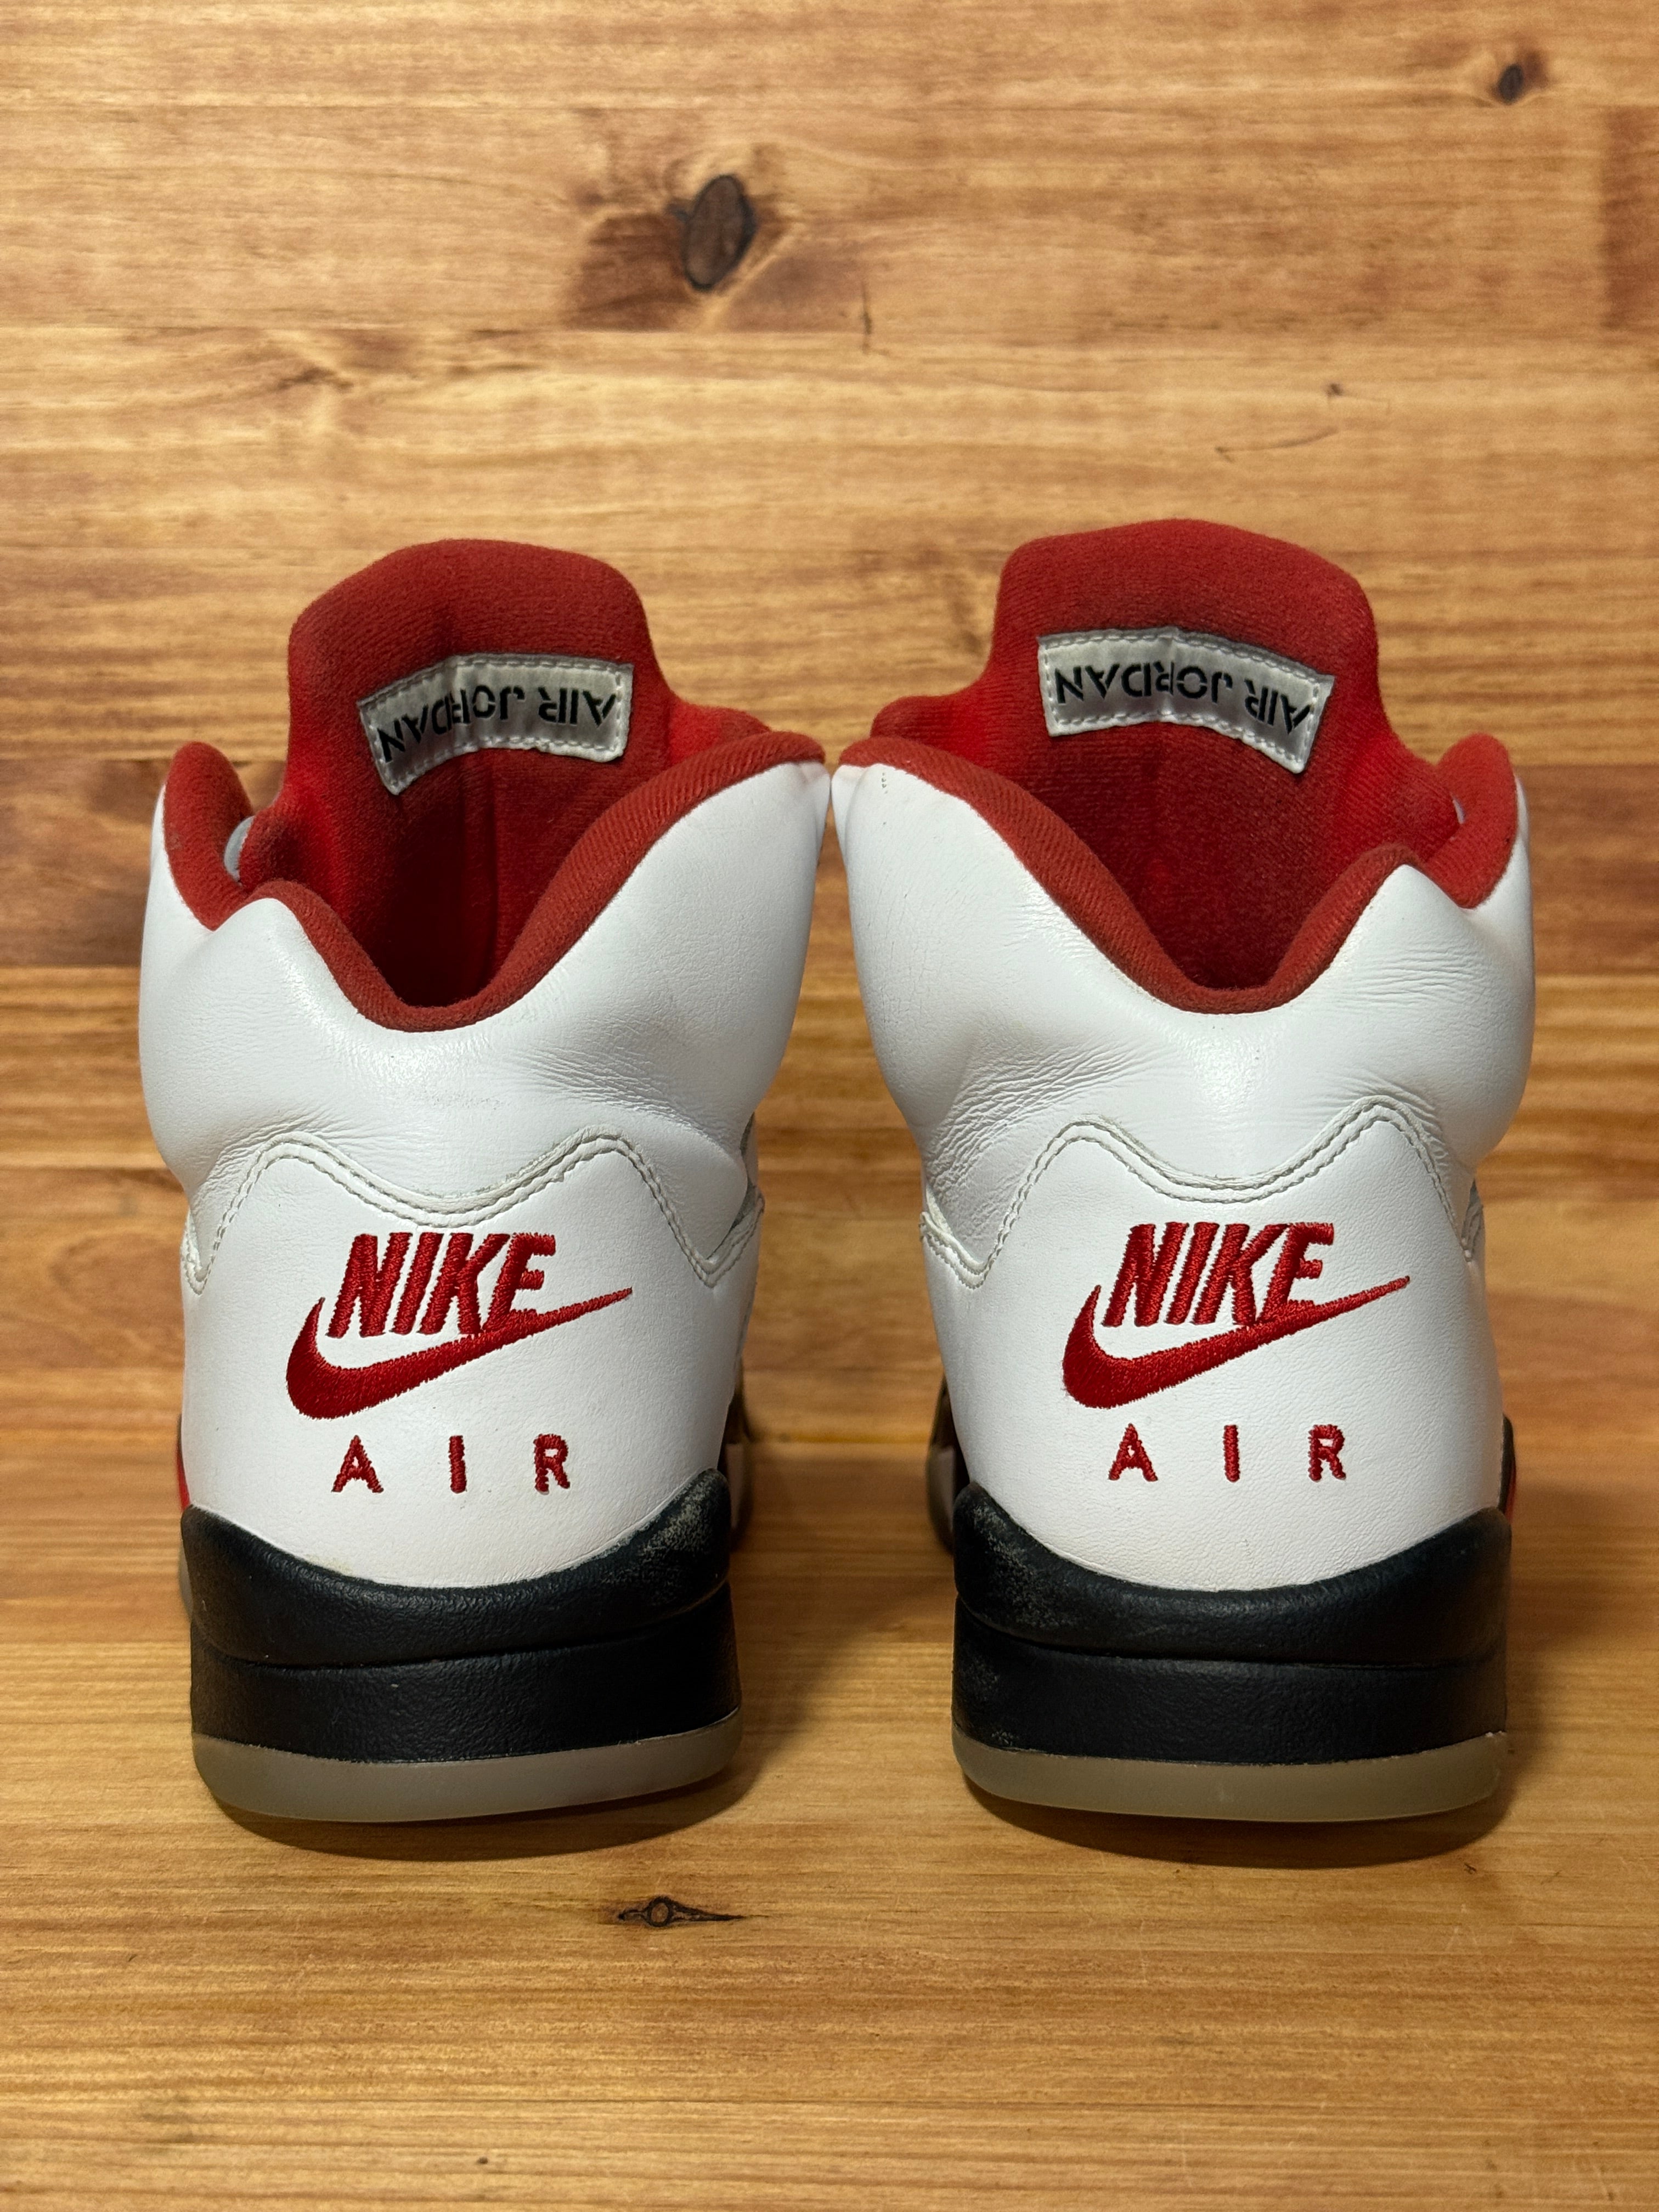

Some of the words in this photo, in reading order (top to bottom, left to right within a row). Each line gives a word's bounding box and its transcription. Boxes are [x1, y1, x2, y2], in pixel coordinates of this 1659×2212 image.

[537, 686, 616, 727] AIR
[1054, 660, 1233, 704] JORDAN
[1244, 678, 1313, 735] AIR
[376, 685, 526, 763] JORDAN
[326, 1232, 556, 1338] NIKE
[1102, 1221, 1334, 1328] NIKE
[331, 1434, 571, 1495] AIR
[1108, 1424, 1346, 1482] AIR
